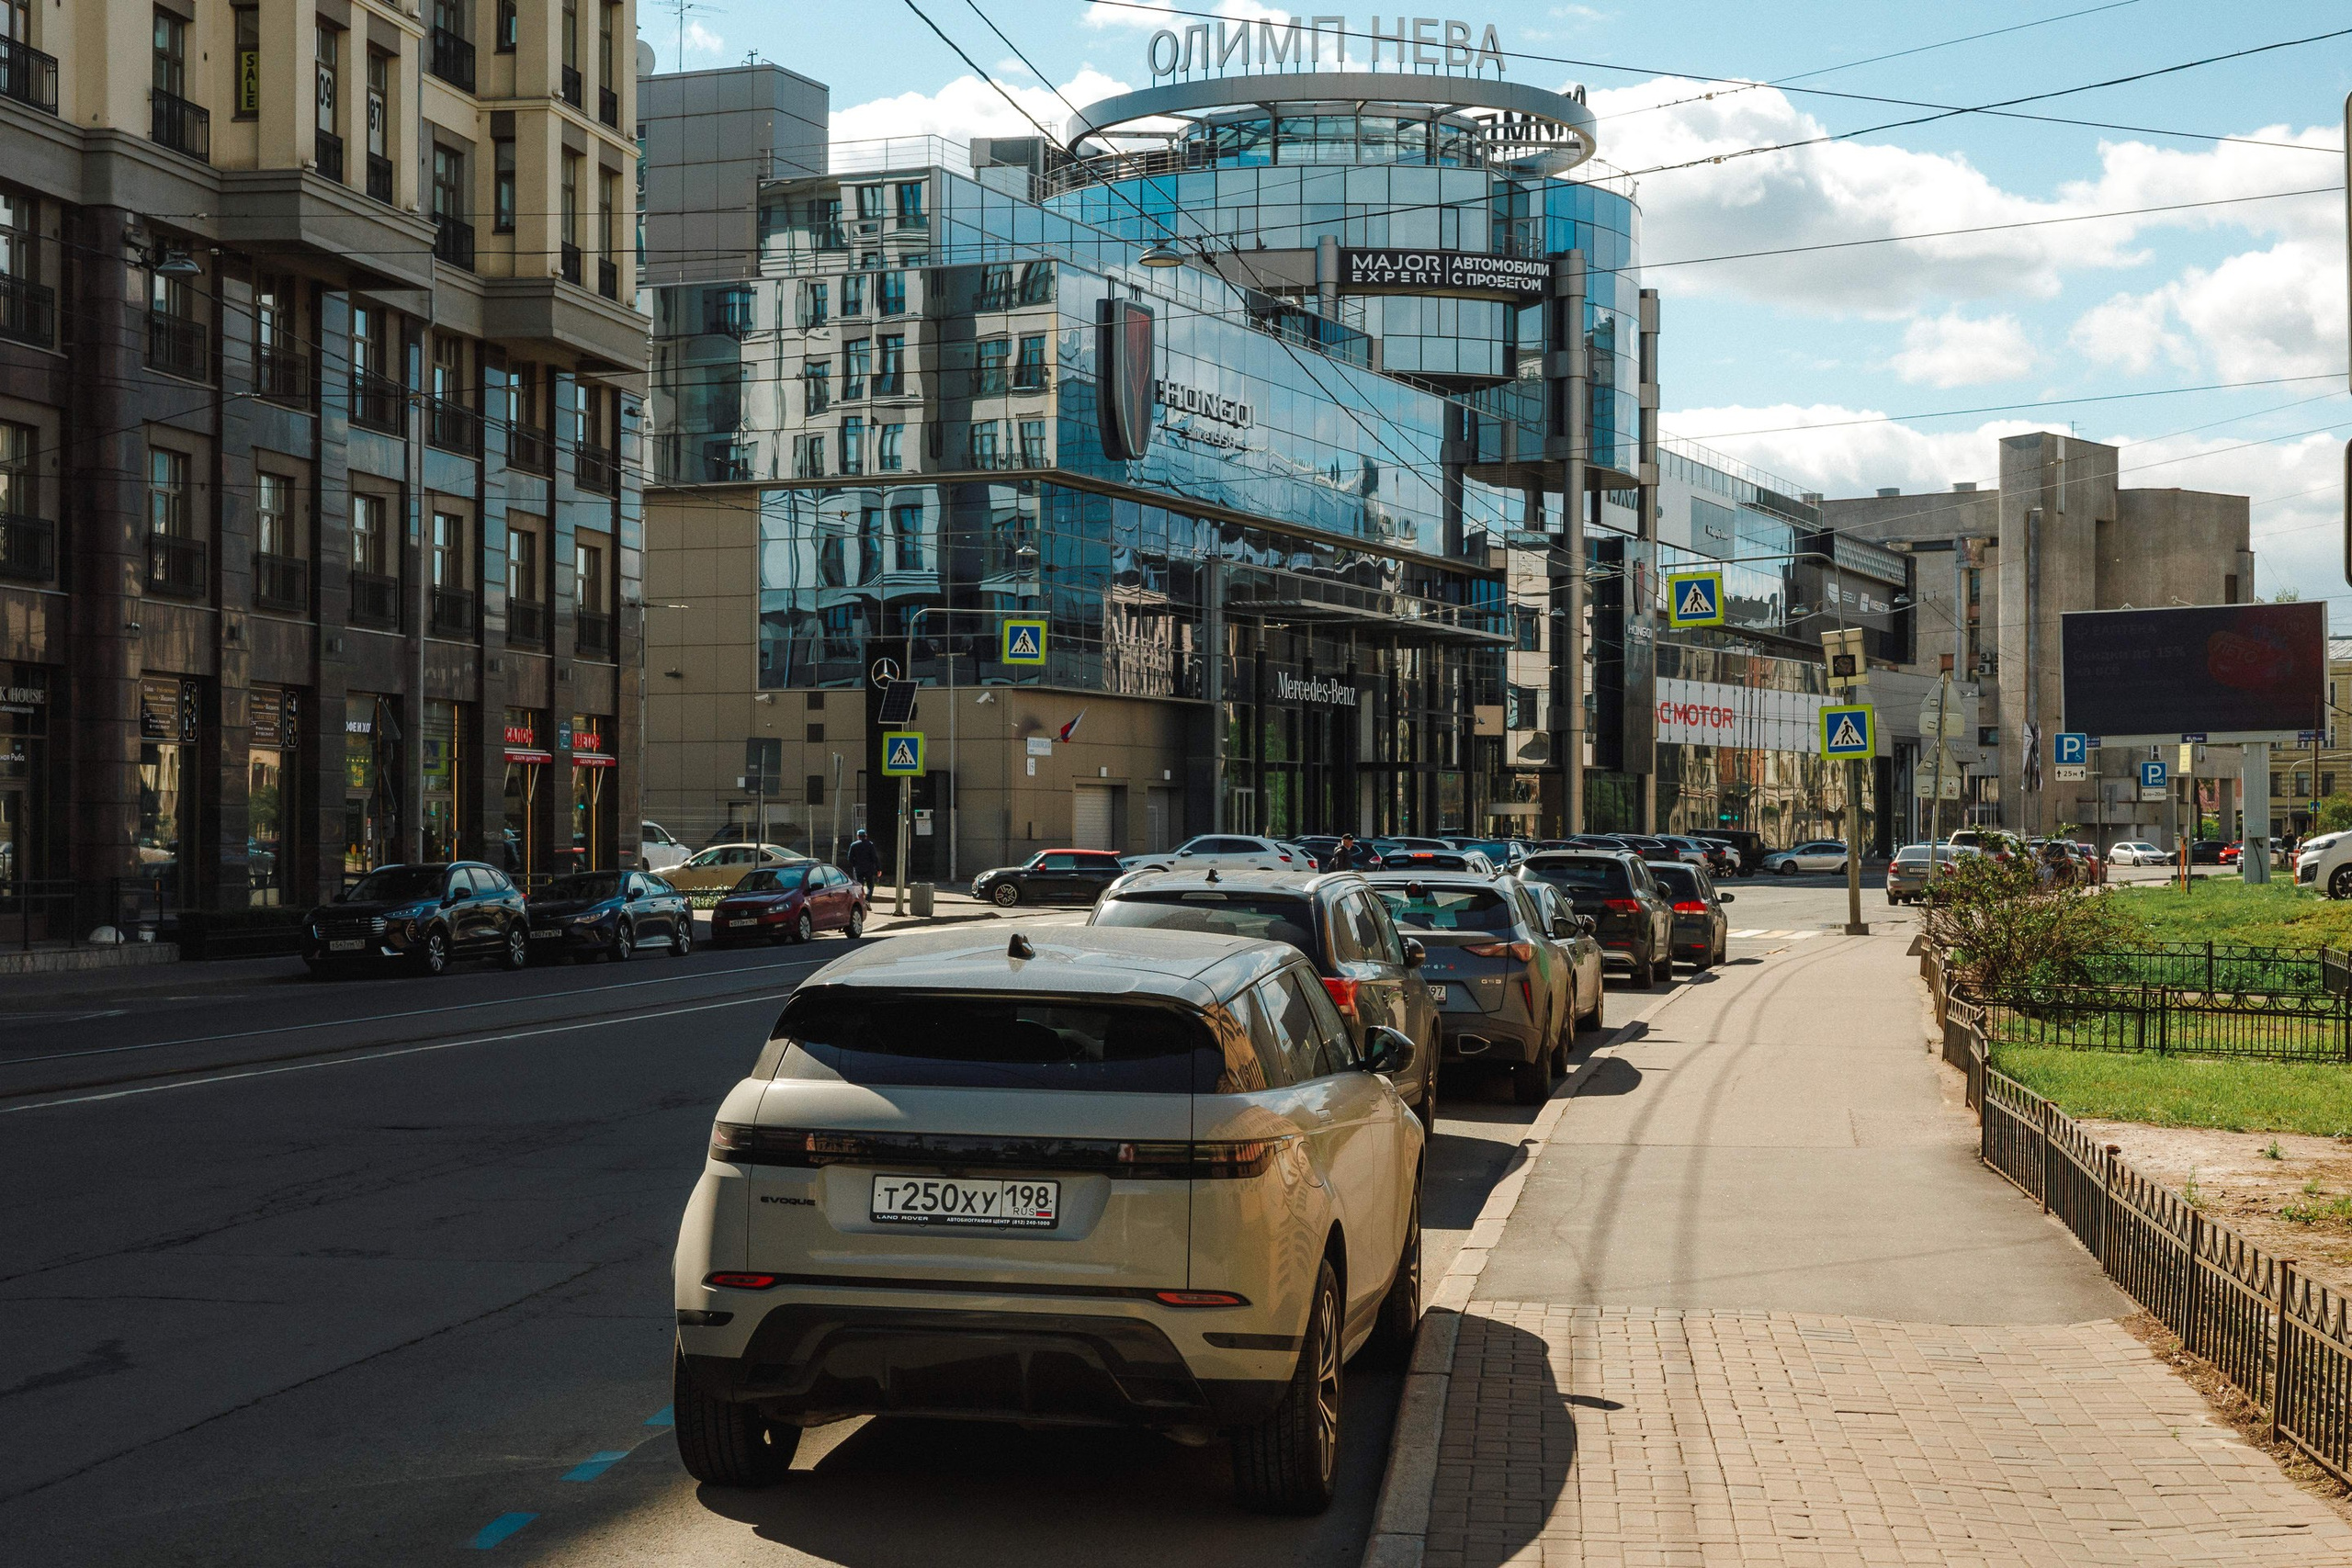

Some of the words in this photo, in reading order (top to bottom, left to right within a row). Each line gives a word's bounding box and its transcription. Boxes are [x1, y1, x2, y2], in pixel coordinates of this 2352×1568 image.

[1148, 16, 1344, 76] ОЛИМП
[1373, 15, 1507, 73] НЕВА
[245, 54, 255, 108] SALE
[319, 73, 332, 109] 09
[369, 97, 381, 132] 87
[1352, 254, 1442, 271] MAJOR
[1452, 256, 1550, 276] АВТОМОБИЛИ
[1352, 271, 1441, 284] EXPERT
[1452, 272, 1463, 285] С
[1466, 273, 1542, 291] ПРОБЕГОМ
[1163, 378, 1256, 429] HONGQI
[2132, 649, 2151, 660] до
[2156, 646, 2186, 659] 15%
[11, 687, 45, 705] HOUSE
[1277, 671, 1356, 706] Mercedes-Benz
[1674, 703, 1733, 729] MOTOR
[504, 726, 534, 743] САЛОН
[11, 753, 25, 761] Рыба
[2064, 738, 2080, 761] P
[2147, 764, 2162, 784] P
[1429, 987, 1443, 997] 97
[760, 1196, 816, 1206] EVOQUE
[1004, 1185, 1049, 1209] 198
[1012, 1207, 1035, 1215] RUS
